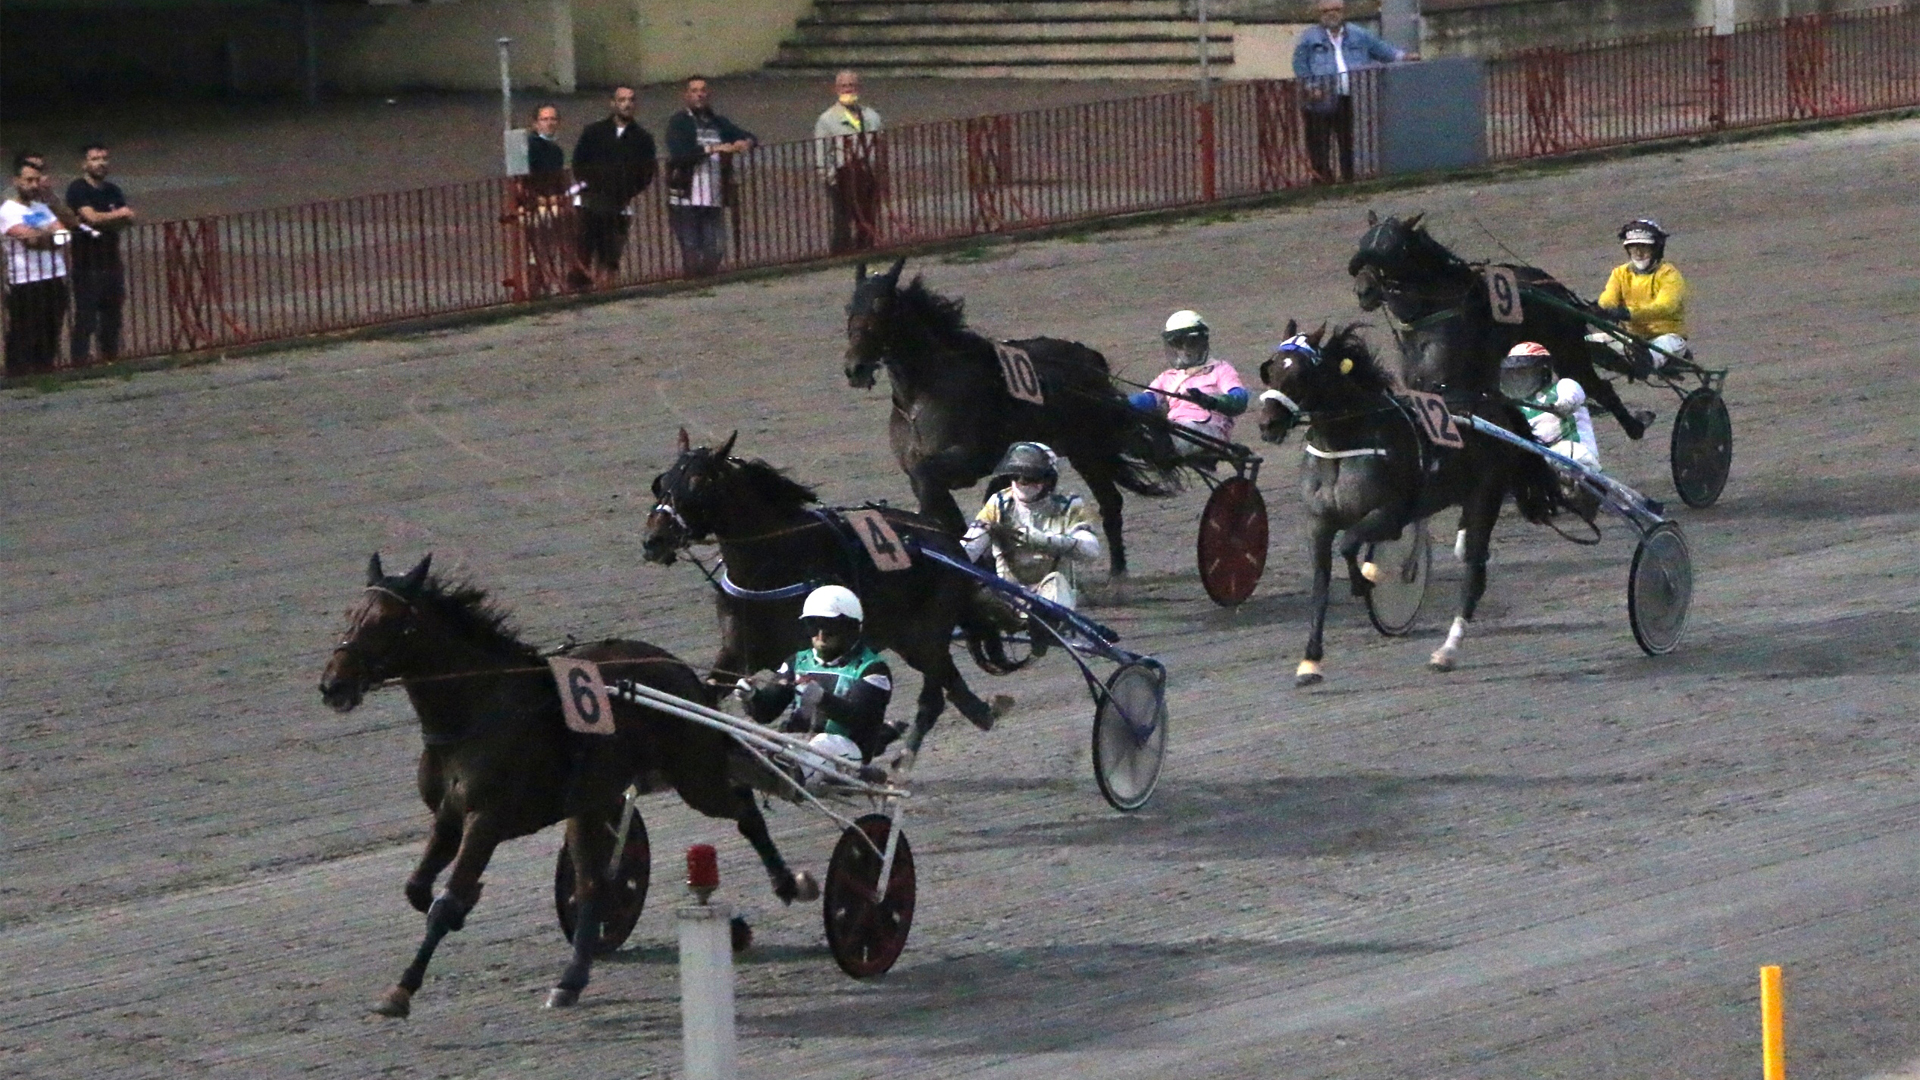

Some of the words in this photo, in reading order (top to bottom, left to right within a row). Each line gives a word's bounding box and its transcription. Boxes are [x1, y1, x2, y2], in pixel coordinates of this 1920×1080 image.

[1494, 273, 1512, 316] 9
[1000, 349, 1038, 396] 10
[1415, 396, 1460, 442] 12
[865, 517, 898, 562] 4
[568, 667, 600, 724] 6
